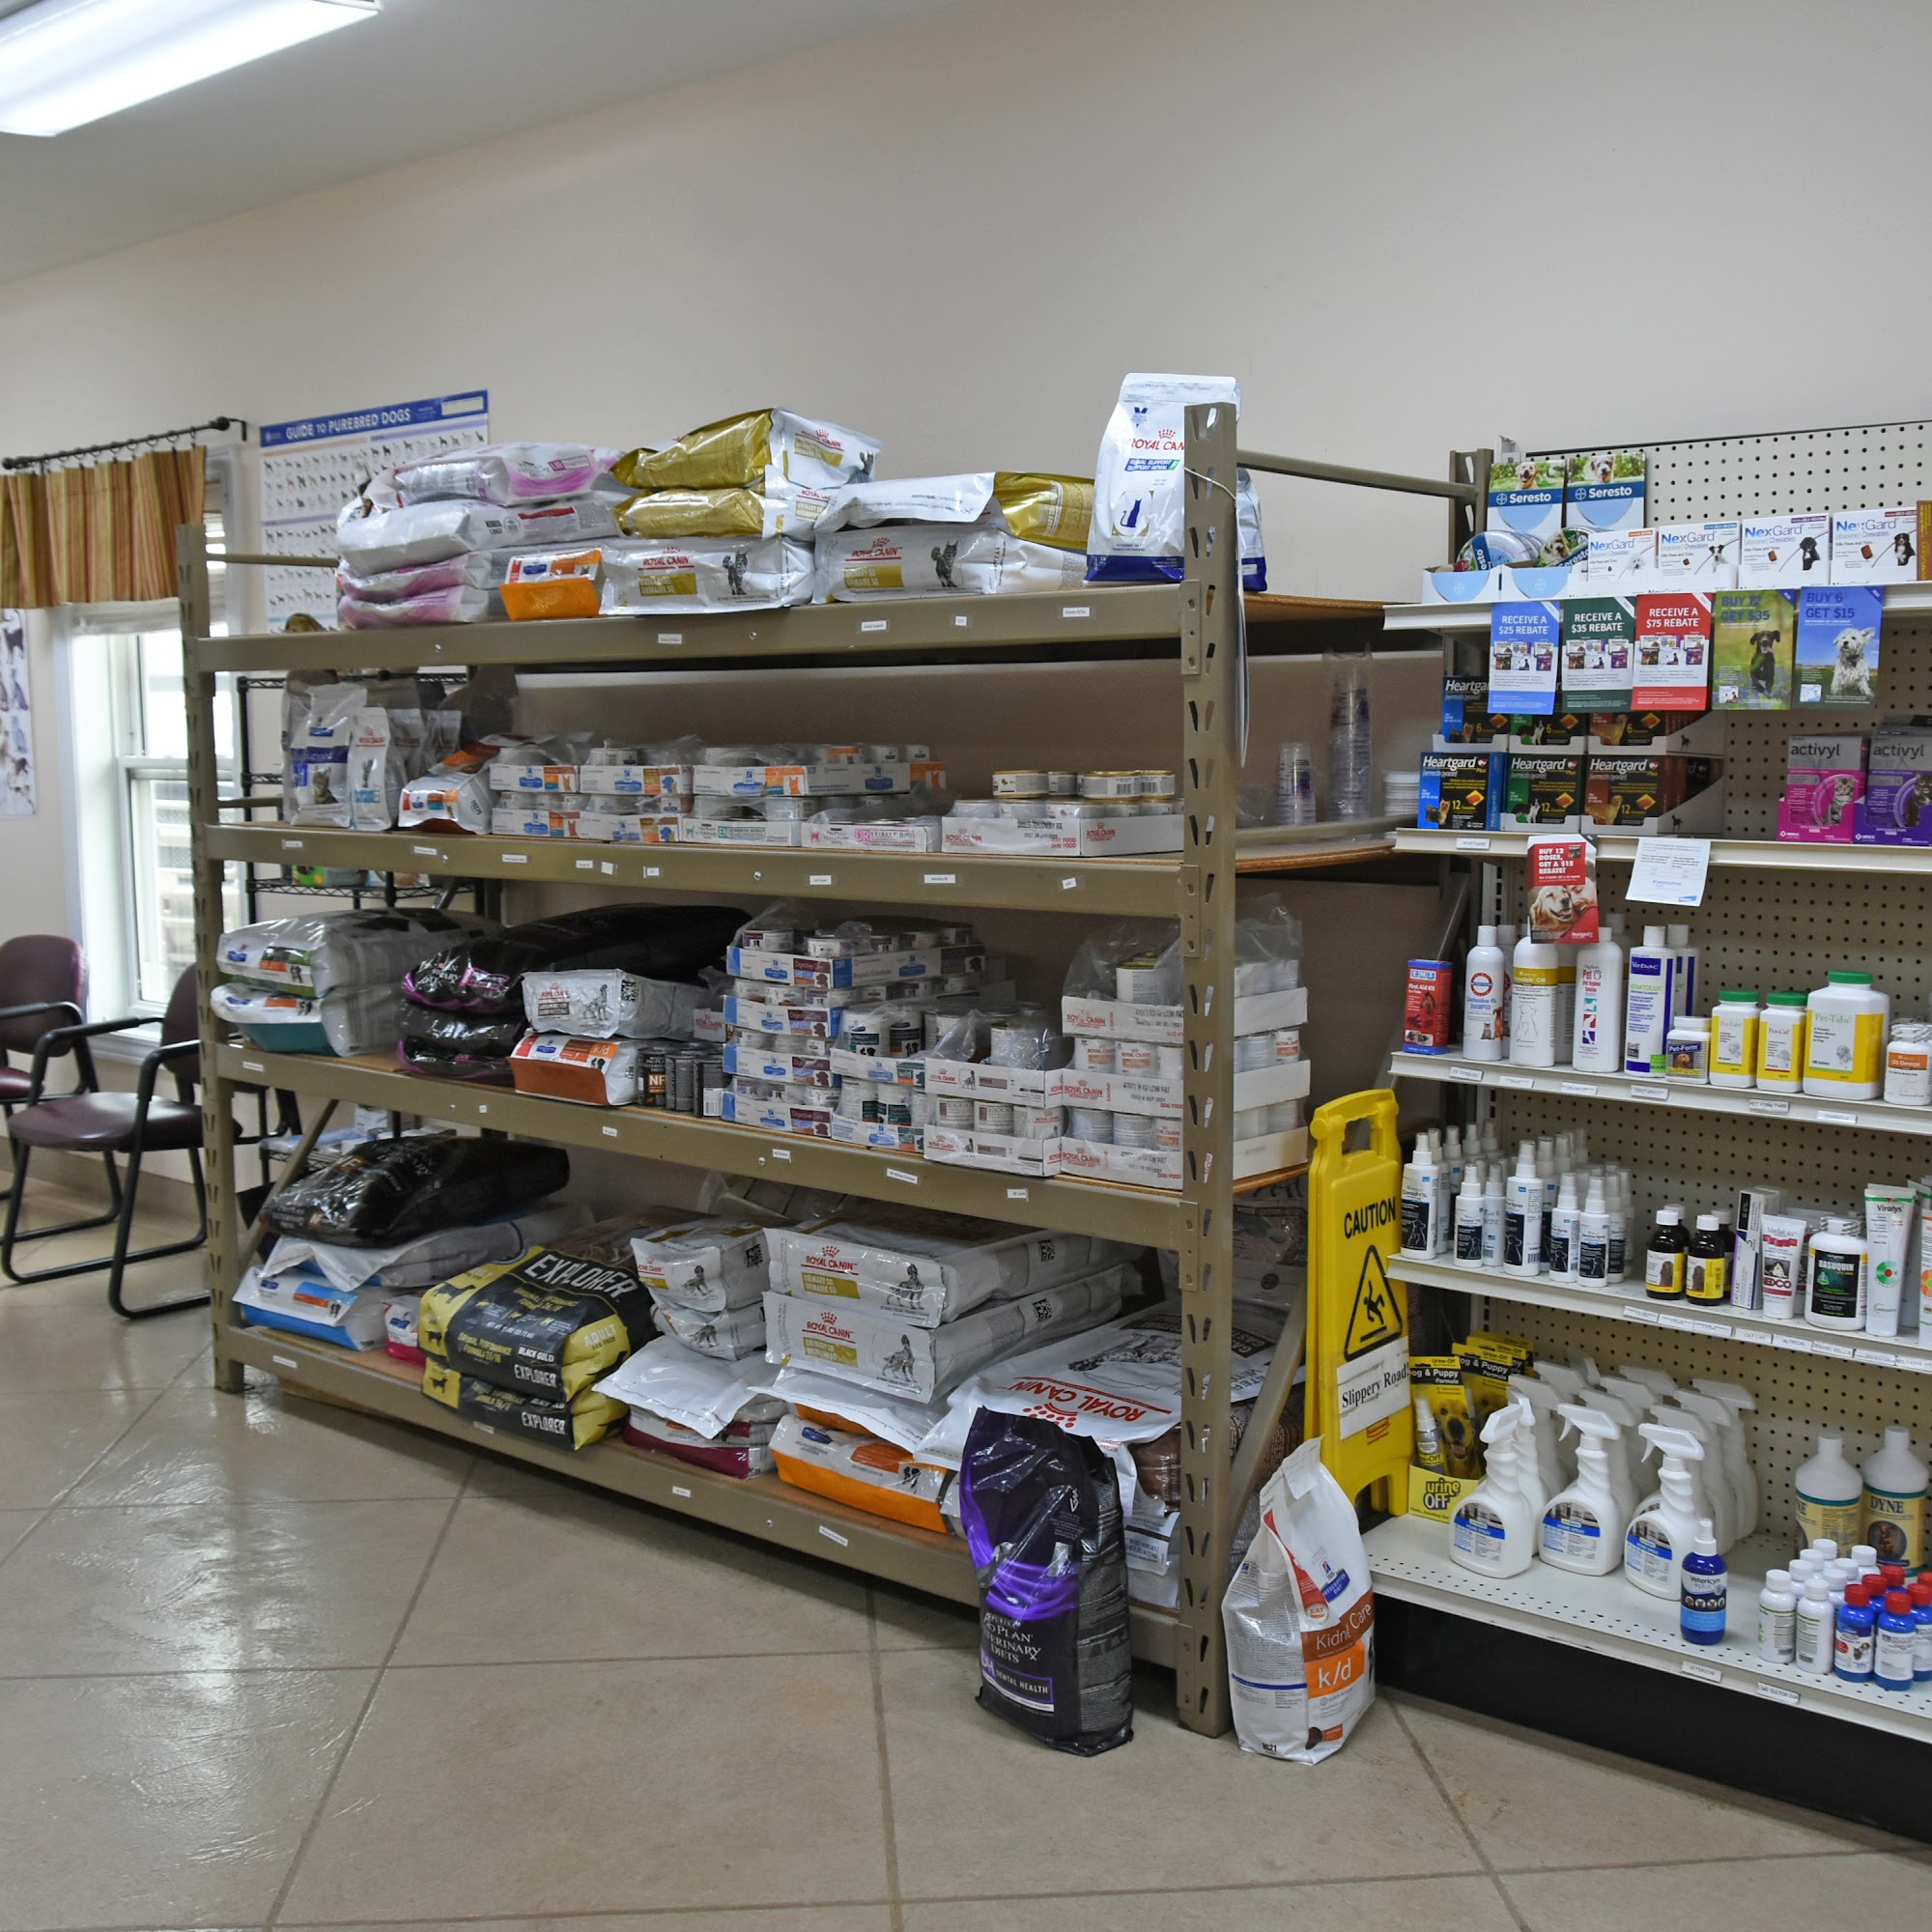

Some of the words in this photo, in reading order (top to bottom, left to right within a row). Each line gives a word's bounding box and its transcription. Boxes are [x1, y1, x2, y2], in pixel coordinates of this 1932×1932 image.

[286, 425, 314, 440] GUIDE
[328, 413, 379, 434] PUREBRED
[382, 409, 411, 425] DOGS
[1589, 486, 1633, 498] Seresto
[1509, 493, 1551, 504] Seresto
[1745, 525, 1803, 537] NexGard
[1835, 519, 1896, 531] NexGard
[1662, 531, 1715, 544] NexGard
[874, 547, 897, 556] CANIN
[1590, 539, 1634, 552] NexGard
[643, 557, 665, 566] ROYAL
[1721, 596, 1746, 607] BUY
[1748, 595, 1762, 606] 12
[1807, 593, 1832, 603] BUY
[1835, 591, 1843, 603] 6
[1575, 612, 1613, 622] RECEIVE
[1649, 608, 1689, 616] RECEIVE
[1691, 608, 1698, 616] A
[1720, 611, 1745, 622] GET
[1747, 610, 1770, 622] $35
[1805, 608, 1831, 618] GET
[1833, 607, 1855, 619] $15
[1502, 615, 1538, 624] RECEIVE
[1541, 615, 1548, 624] A
[1646, 618, 1662, 628] $75
[1664, 618, 1698, 628] REBATE
[1499, 626, 1514, 635] $25
[1571, 624, 1586, 634] $35
[1588, 623, 1623, 632] REBATE
[1445, 680, 1490, 695] Heartga
[1476, 724, 1482, 732] 6
[1546, 724, 1551, 733] 6
[1627, 724, 1633, 734] 6
[1791, 744, 1839, 759] activyl
[1873, 744, 1924, 759] activyl
[1422, 755, 1476, 771] Heartgard
[1511, 757, 1565, 773] Heartgard
[1589, 759, 1647, 775] Heartgard
[1452, 800, 1461, 810] 12
[1542, 803, 1550, 811] 12
[1621, 804, 1631, 814] 12
[1582, 970, 1592, 980] Pet
[1816, 1014, 1849, 1024] Pet-Tabs
[1768, 1027, 1789, 1036] Pet-Cal
[593, 1046, 611, 1055] k/d
[649, 1074, 666, 1086] NF
[1063, 1151, 1080, 1161] ROYAL
[1081, 1154, 1101, 1163] CANIN
[1877, 1205, 1903, 1213] Viralys
[1344, 1196, 1397, 1239] CAUTION
[1768, 1227, 1794, 1236] VedaLax
[806, 1256, 827, 1267] ROYAL
[829, 1260, 854, 1271] CANIN
[1818, 1260, 1855, 1271] DASUQUIN
[524, 1254, 639, 1298] EXPLORER
[583, 1324, 616, 1347] ADULT
[807, 1321, 827, 1333] ROYAL
[829, 1326, 851, 1339] CANIN
[519, 1347, 536, 1358] BLACK
[537, 1351, 554, 1363] GOLD
[1482, 1350, 1509, 1360] Urine-Off
[1434, 1368, 1459, 1379] Puppy
[1482, 1361, 1509, 1375] Puppy
[514, 1364, 556, 1387] EXPLORER
[1483, 1370, 1507, 1380] Formula
[1342, 1379, 1381, 1408] Slippery
[1383, 1362, 1410, 1389] Road!
[1006, 1380, 1072, 1404] CANIN
[1077, 1395, 1146, 1422] ROYAL
[522, 1412, 565, 1435] EXPLORER
[1426, 1480, 1461, 1495] urine
[1424, 1493, 1449, 1510] OFF
[1870, 1496, 1904, 1514] DYNE
[1350, 1604, 1372, 1630] Care
[998, 1626, 1032, 1642] PLAN
[985, 1632, 1041, 1661] TERINARY
[990, 1643, 1020, 1663] DIETS
[981, 1649, 996, 1677] DH
[1319, 1658, 1351, 1689] k/d
[996, 1669, 1017, 1687] DENTAL
[1020, 1681, 1049, 1694] HEALTH
